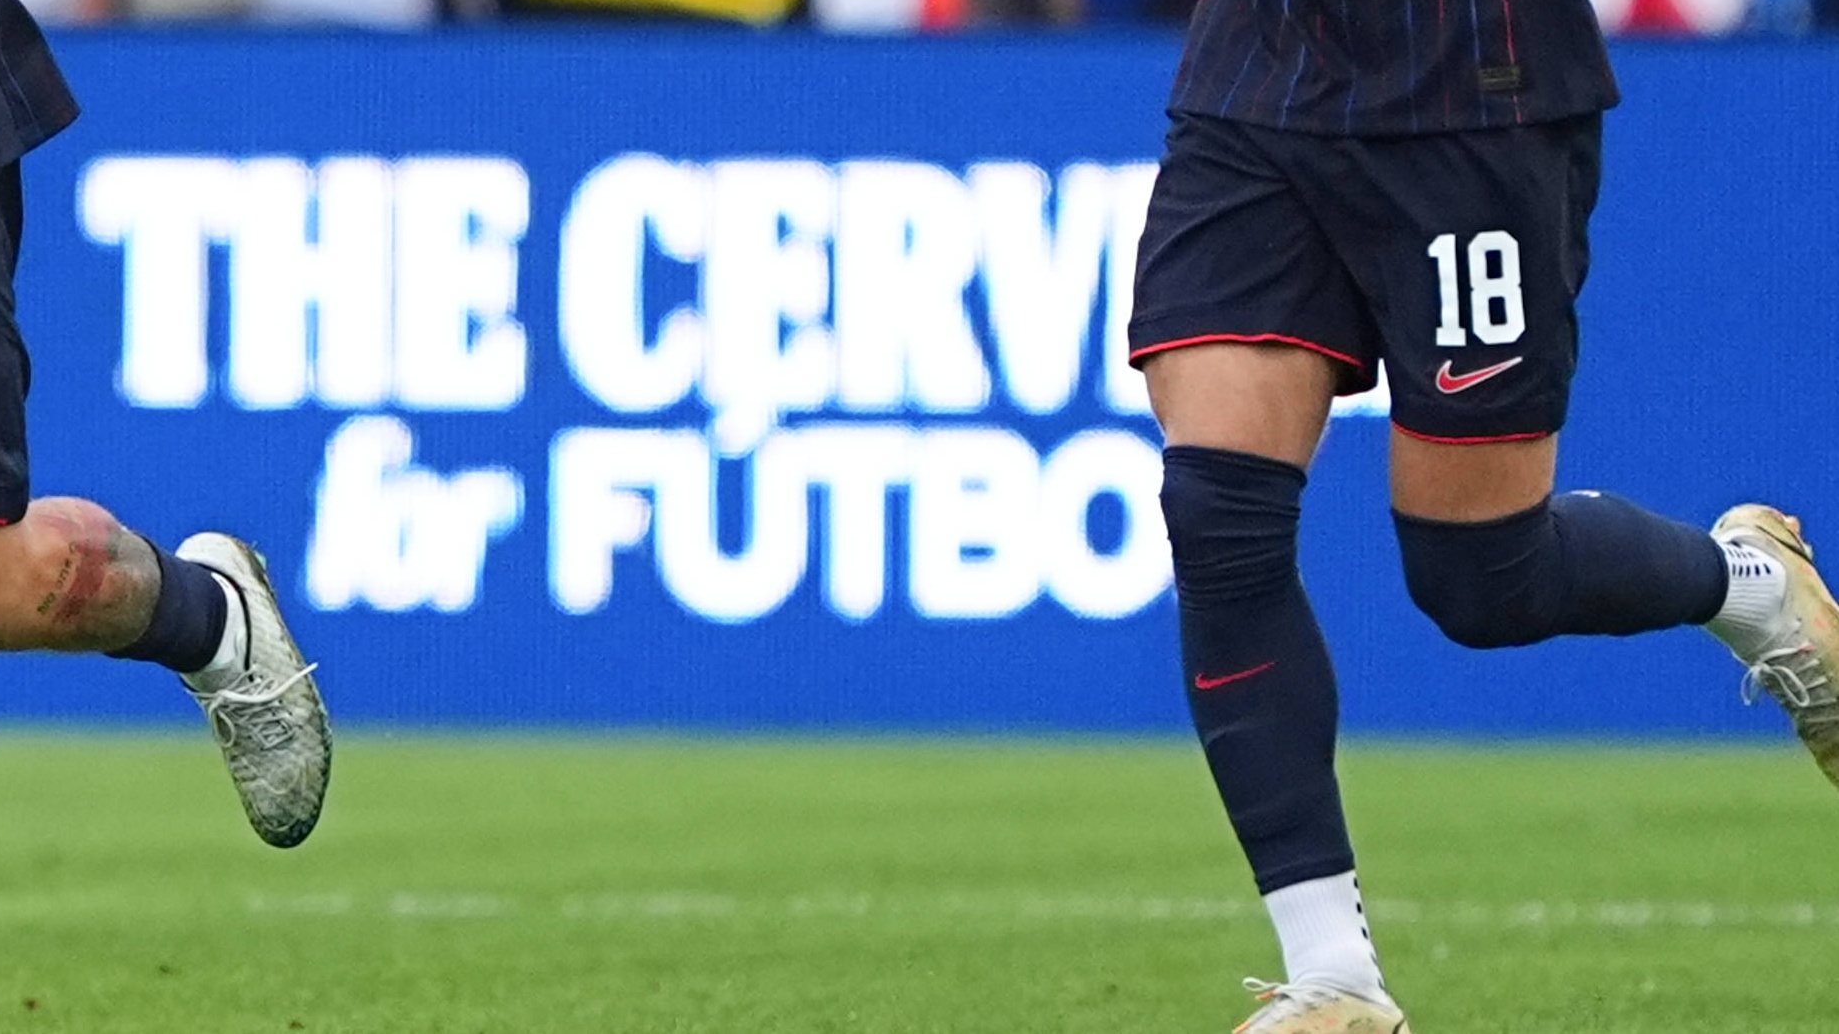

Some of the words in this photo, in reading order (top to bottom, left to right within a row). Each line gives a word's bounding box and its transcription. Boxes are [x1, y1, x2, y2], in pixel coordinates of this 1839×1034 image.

[76, 152, 530, 412] THE
[558, 151, 1391, 414] CERV
[1426, 229, 1527, 348] 18
[300, 414, 526, 612] for
